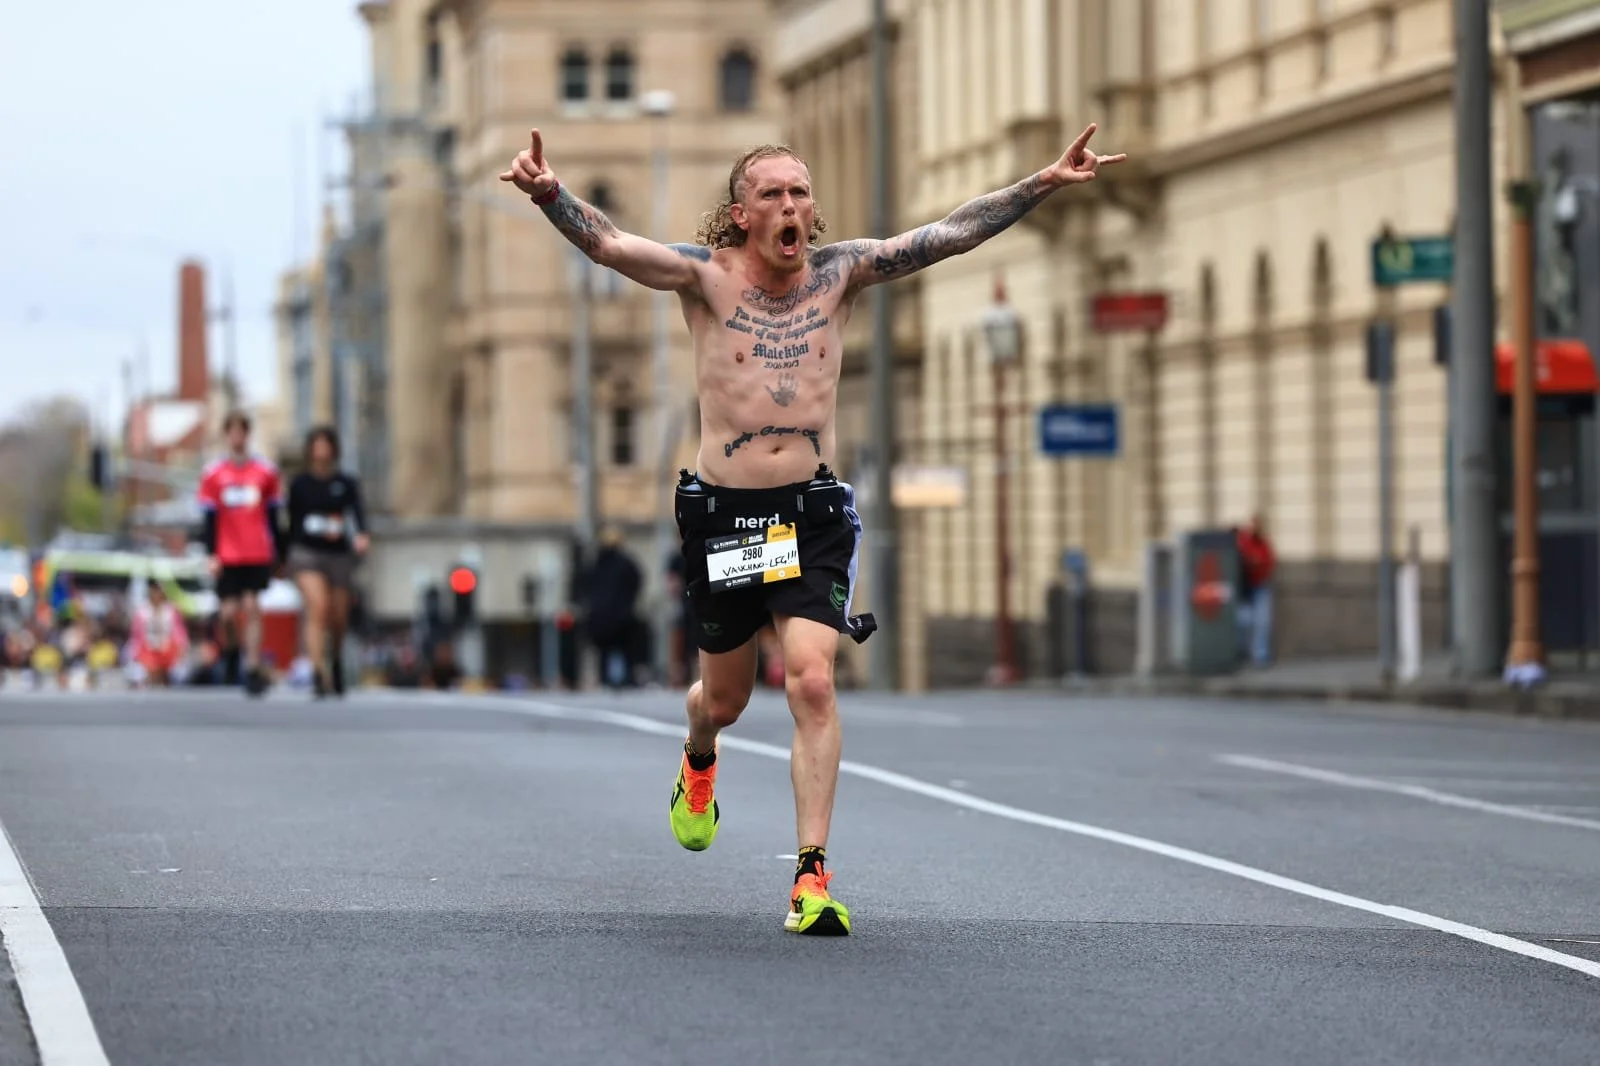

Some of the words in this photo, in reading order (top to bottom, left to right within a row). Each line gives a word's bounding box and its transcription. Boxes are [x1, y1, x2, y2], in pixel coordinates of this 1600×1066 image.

[752, 340, 809, 359] Malekhai
[735, 513, 780, 528] nerd
[742, 547, 763, 560] 2980
